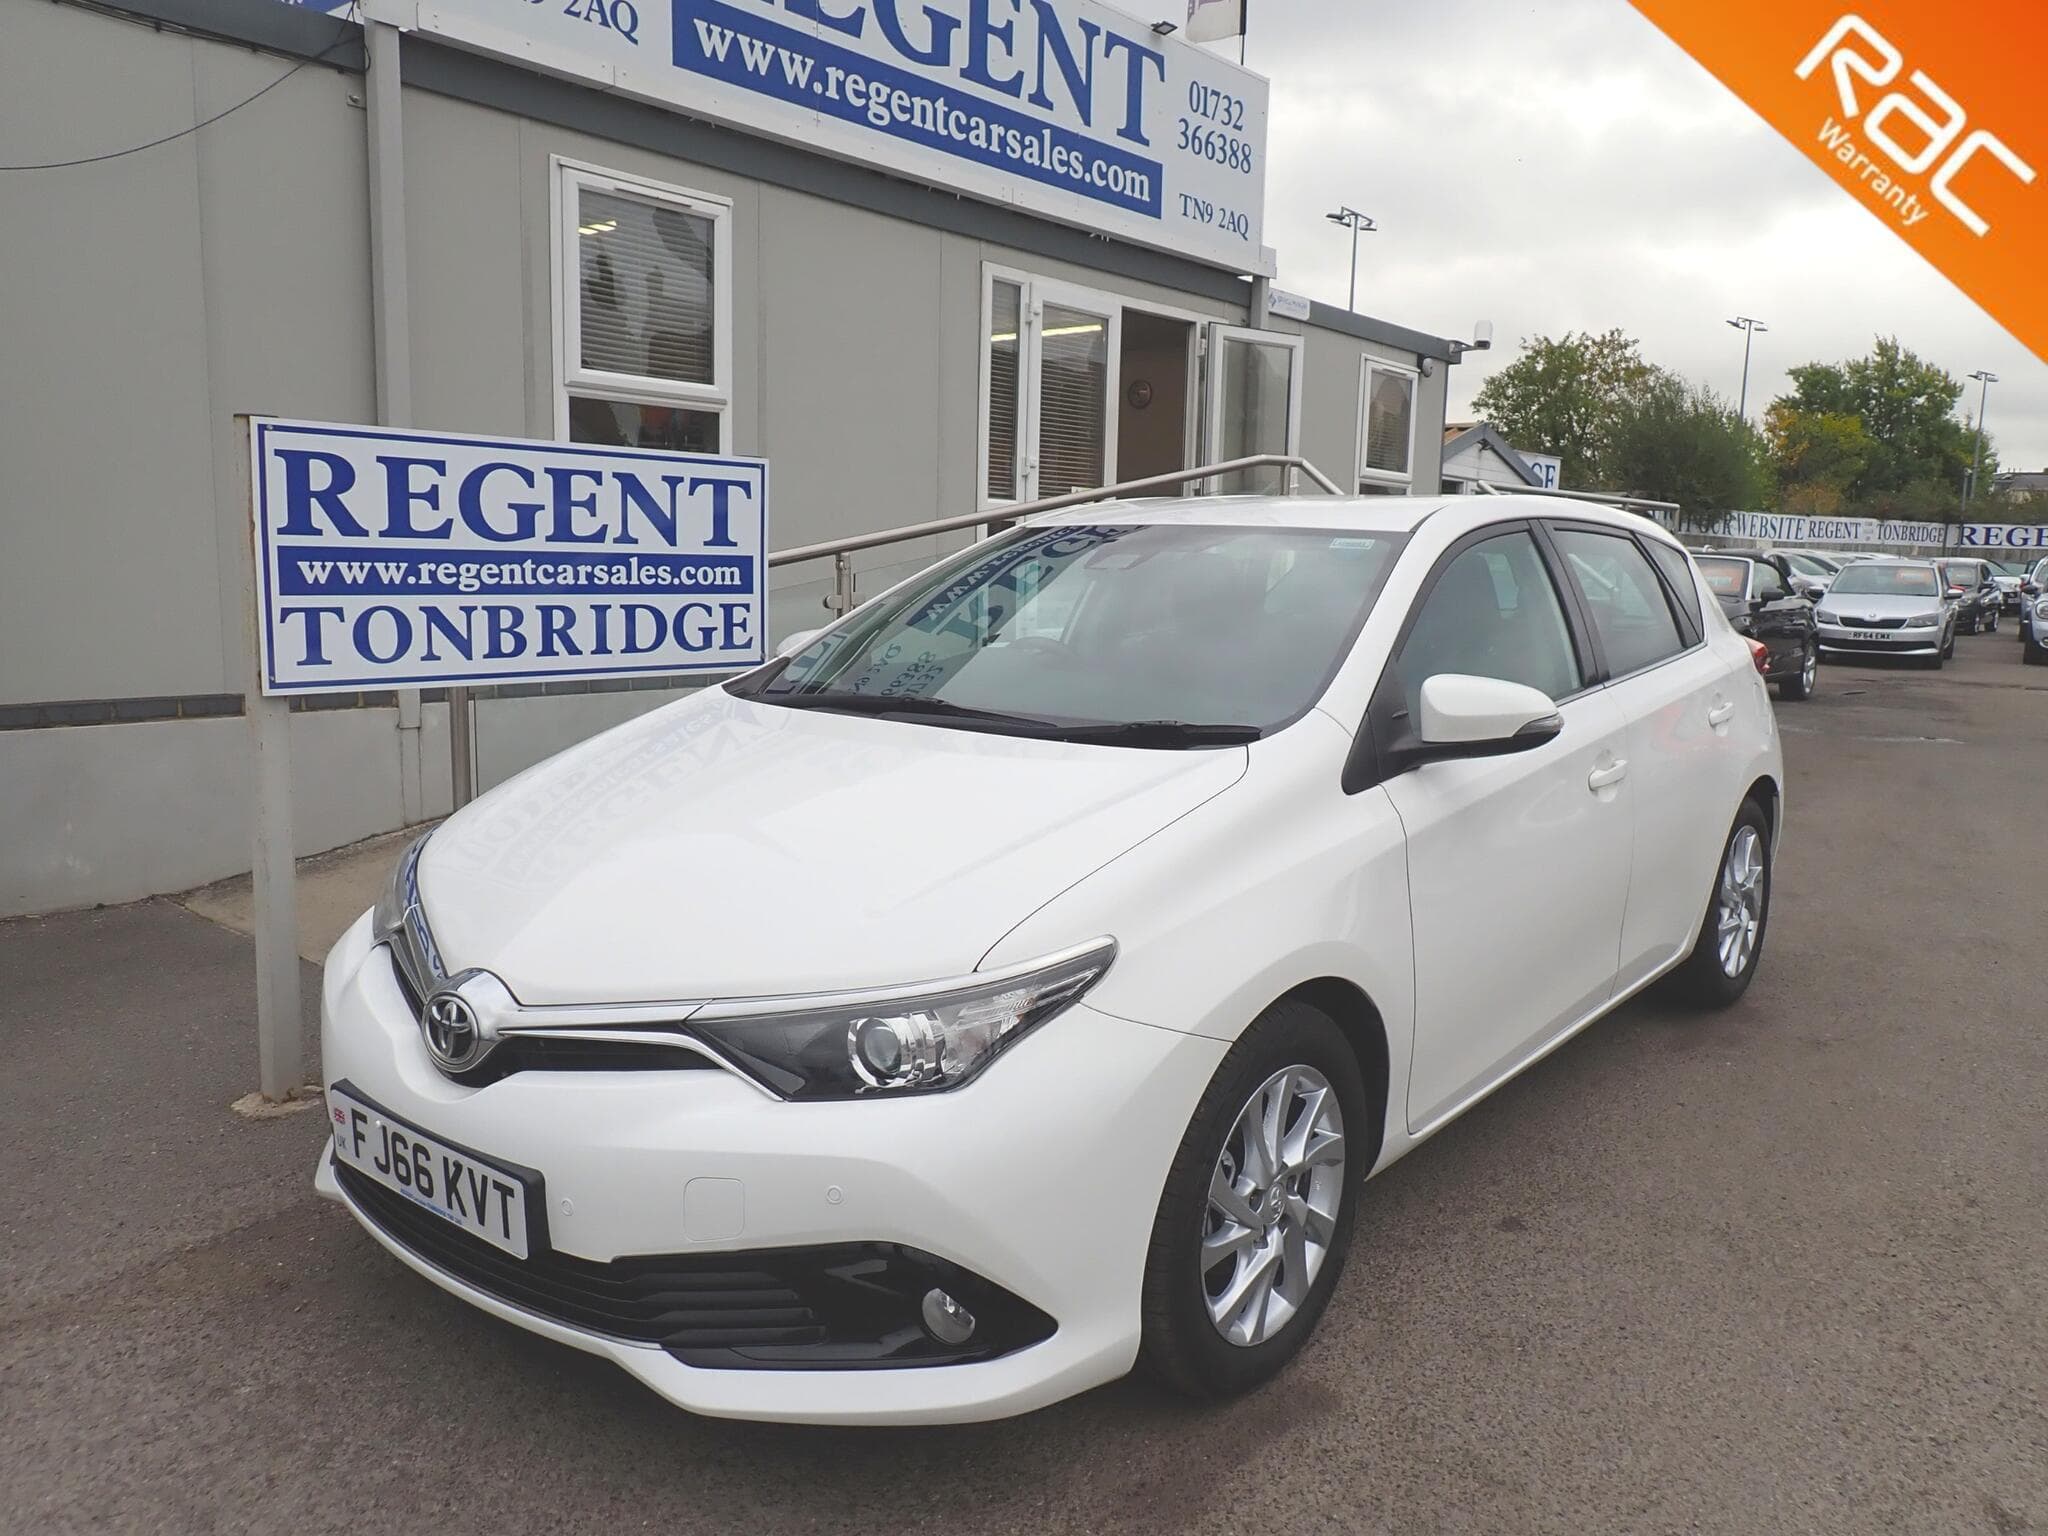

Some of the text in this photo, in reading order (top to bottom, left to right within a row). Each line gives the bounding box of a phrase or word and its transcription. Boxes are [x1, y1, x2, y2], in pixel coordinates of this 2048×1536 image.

[692, 19, 1151, 203] www.regentcarsales.com
[1189, 80, 1244, 132] 01732
[1177, 118, 1252, 174] 366388
[1179, 193, 1249, 241] TN9 2AQ
[274, 448, 752, 547] REGENT
[1734, 512, 1805, 540] WEBSITE
[1808, 520, 1861, 539] REGENT
[1876, 523, 1945, 543] TONBRIDGE
[297, 556, 741, 592] www.regentcarsales.com
[279, 602, 753, 667] TONBRIDGE
[351, 1107, 434, 1199] FJ66
[443, 1155, 516, 1241] KVT
